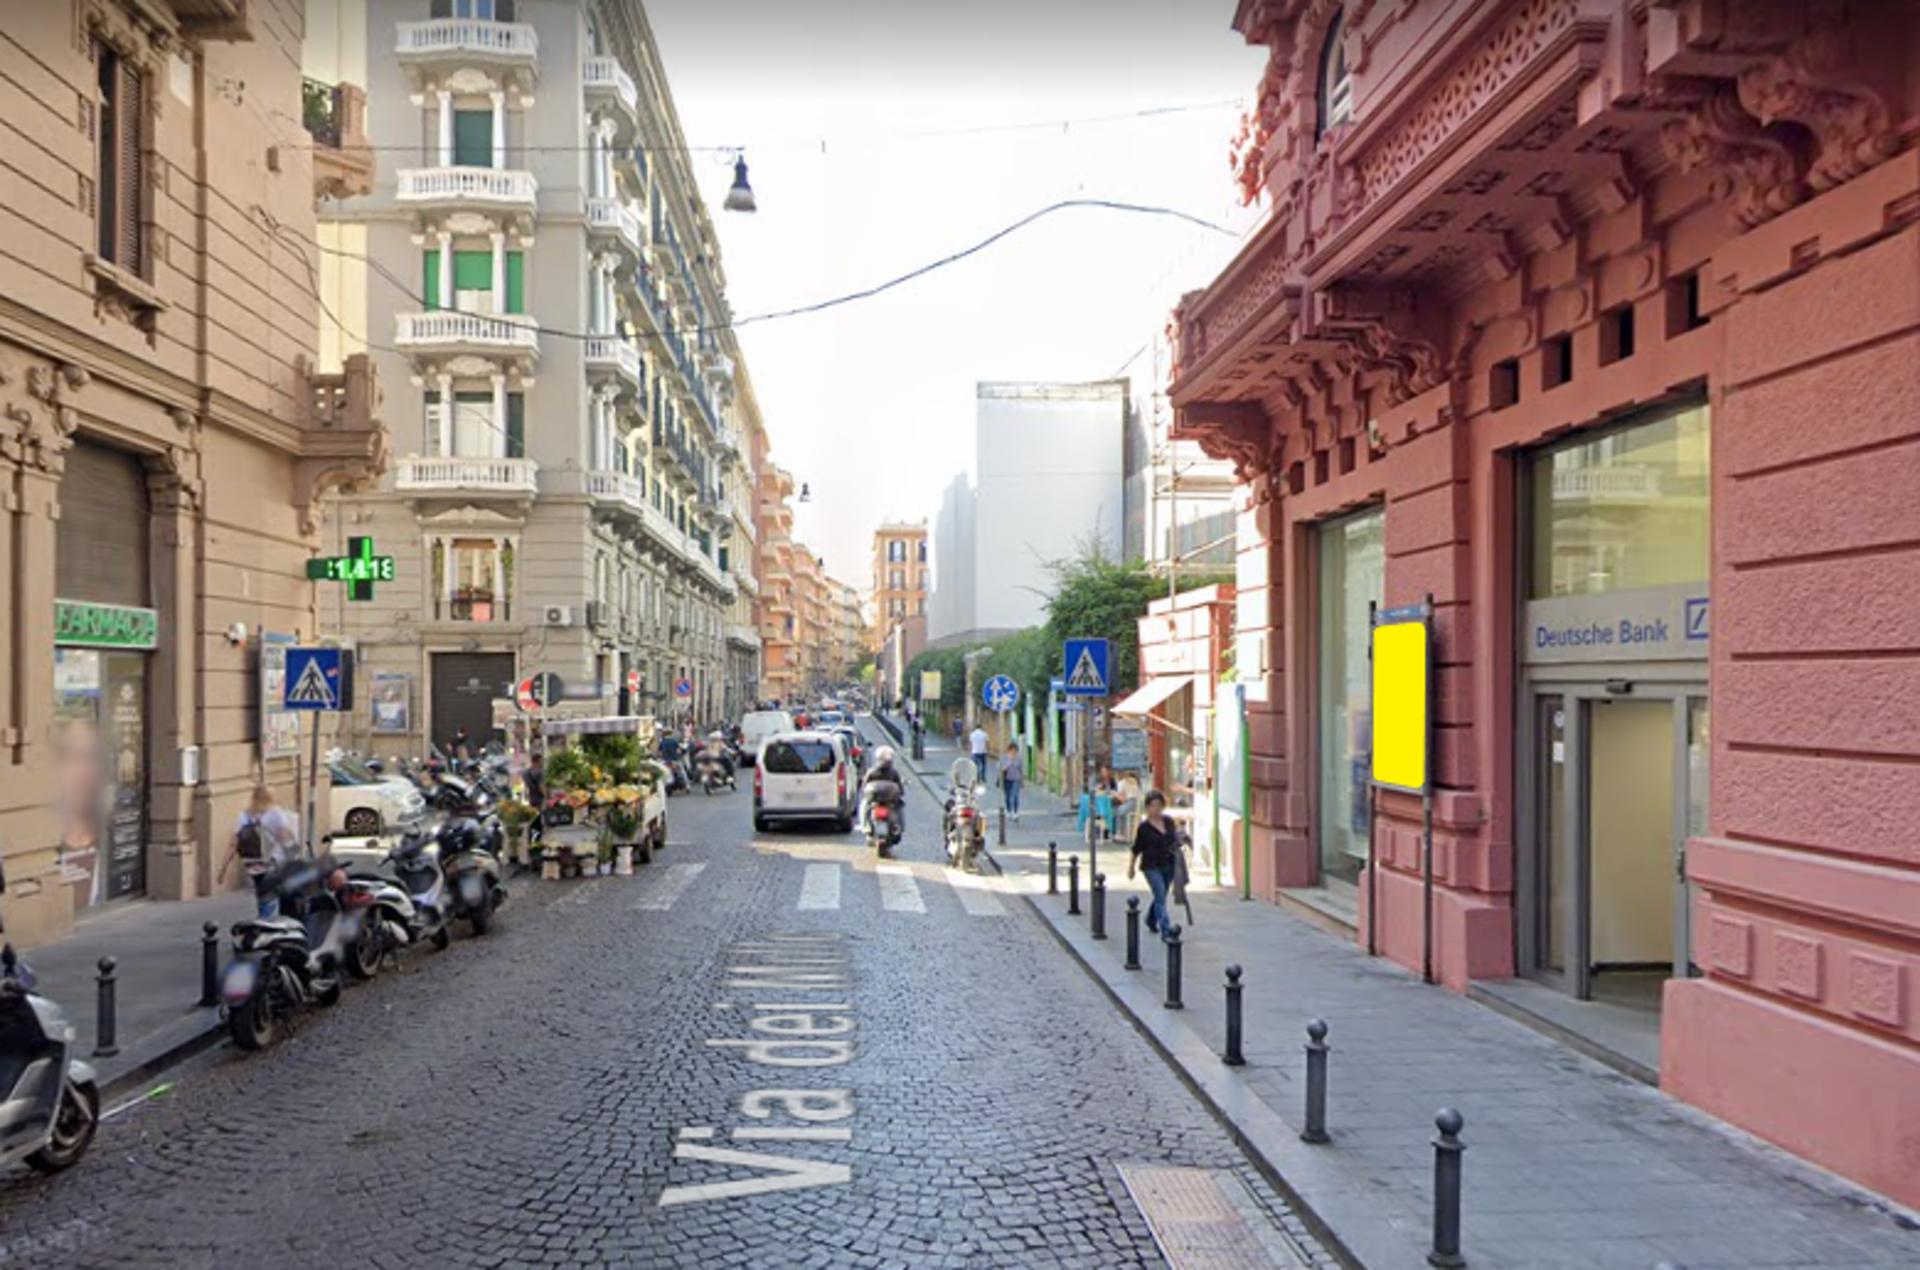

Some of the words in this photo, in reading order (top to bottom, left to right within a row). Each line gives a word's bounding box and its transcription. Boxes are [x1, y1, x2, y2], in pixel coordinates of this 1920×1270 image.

[58, 603, 155, 644] FARMACIA
[1536, 623, 1614, 648] Deutsche
[1619, 618, 1669, 643] Bank
[704, 1002, 856, 1068] dei
[659, 1088, 856, 1206] Via
